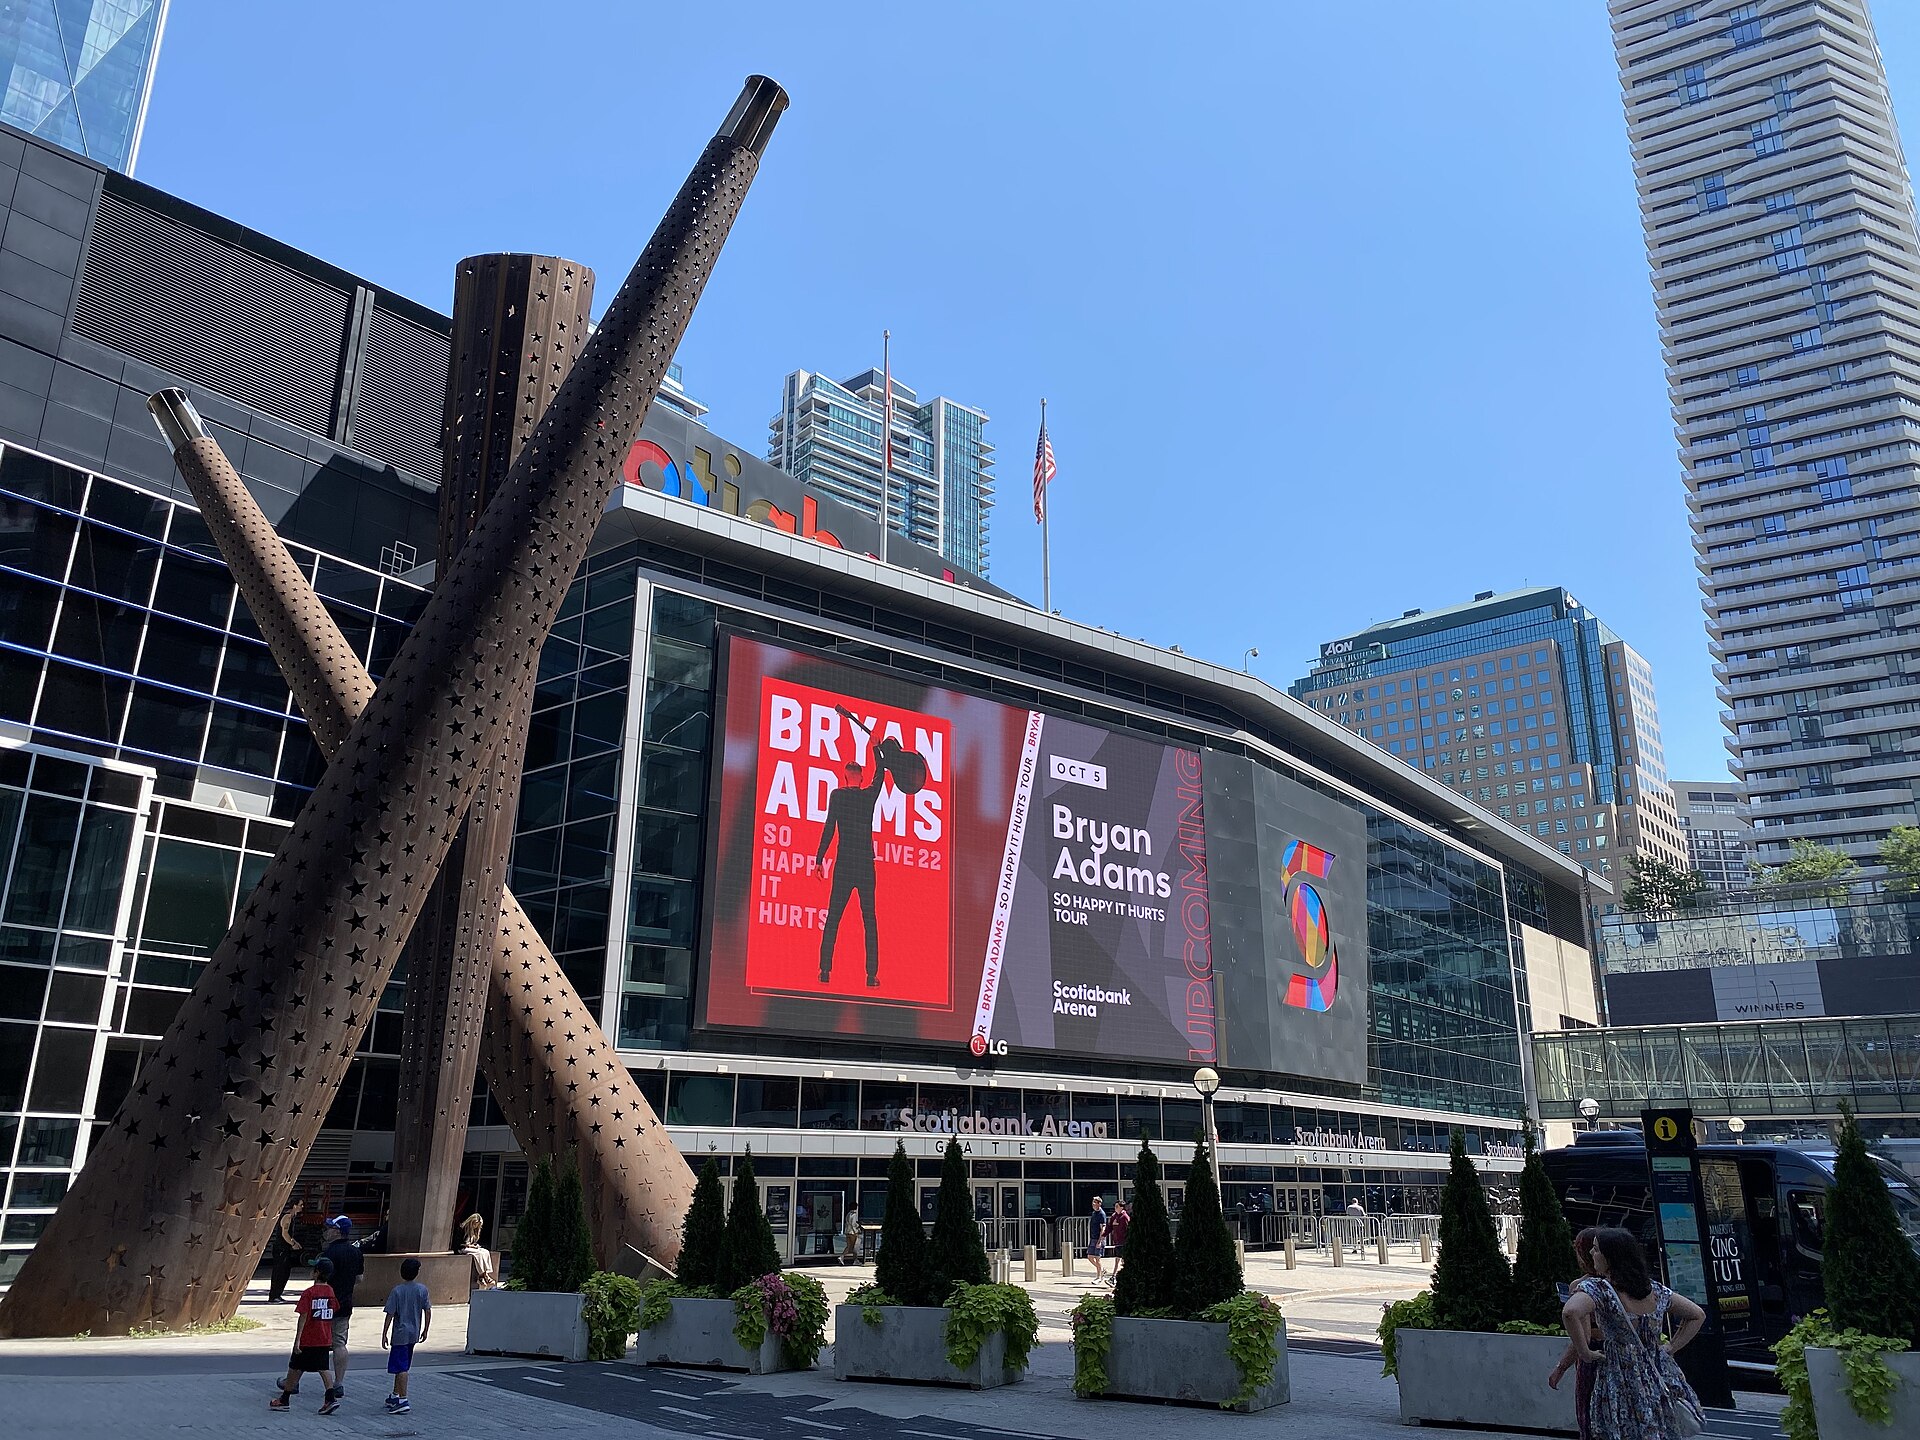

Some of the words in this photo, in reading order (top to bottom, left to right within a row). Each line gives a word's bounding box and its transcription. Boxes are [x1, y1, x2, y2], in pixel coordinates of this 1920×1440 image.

[1020, 757, 1034, 789] TOUR
[1057, 763, 1086, 778] OCT
[1094, 771, 1101, 782] 5
[764, 760, 942, 842] ADMS
[1013, 794, 1026, 833] HURTS
[763, 823, 792, 847] SO
[1009, 834, 1020, 847] IT
[1053, 803, 1152, 855] Bryan
[762, 848, 833, 879] HAPPY
[873, 841, 914, 867] LIVE
[918, 848, 941, 870] 22
[1002, 849, 1017, 890] HAPPY
[760, 875, 782, 898] IT
[1053, 846, 1172, 898] Adams
[999, 892, 1009, 910] SO
[1053, 892, 1071, 906] SO
[1072, 895, 1113, 914] HAPPY
[1115, 901, 1126, 916] IT
[1127, 905, 1165, 922] HURTS
[1175, 748, 1217, 1063] UPCOMING
[759, 901, 829, 931] HURTS
[1053, 908, 1089, 926] TOUR
[990, 919, 1005, 966] ADAMS
[982, 967, 996, 1011] BRYAN
[1053, 980, 1131, 1005] Scotiabank
[1053, 998, 1097, 1017] Arena
[1735, 1002, 1805, 1013] WINNERS
[988, 1039, 1008, 1055] LG
[900, 1108, 1033, 1136] Scotiabank
[1041, 1115, 1107, 1138] Arena
[935, 1140, 1026, 1155] GATE
[1045, 1143, 1053, 1156] 6
[1295, 1126, 1356, 1149] Scotiabank
[1358, 1131, 1386, 1150] Arena
[1313, 1152, 1353, 1164] GATE
